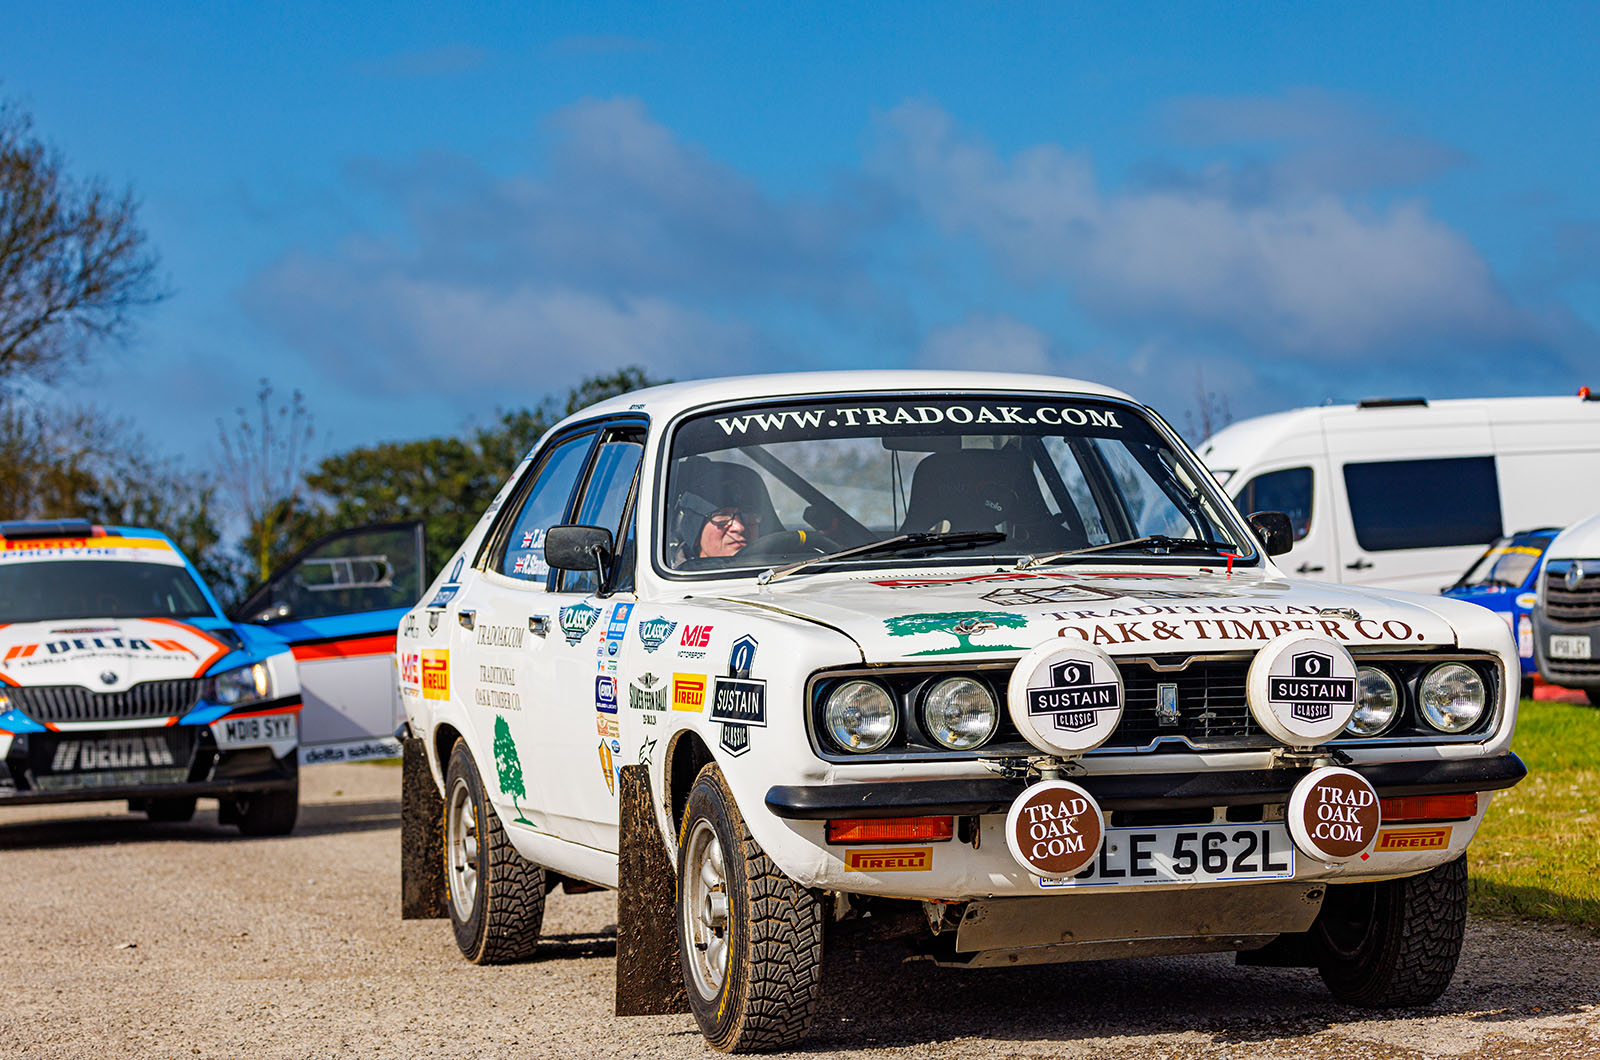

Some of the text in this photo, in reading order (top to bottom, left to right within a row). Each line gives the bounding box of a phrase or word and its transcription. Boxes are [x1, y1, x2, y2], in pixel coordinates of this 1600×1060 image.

[715, 405, 1122, 436] WWW.TRADOAK.COM
[565, 608, 594, 629] CLASSIC
[644, 623, 669, 639] CLASSIC
[680, 625, 714, 647] MIS
[1354, 619, 1425, 641] CO.
[46, 638, 152, 654] DELTA
[422, 659, 447, 690] PIRELLI
[480, 665, 516, 686] TRADITIONAL
[675, 680, 704, 706] PIRELLI
[717, 689, 759, 714] SUSTAIN
[1038, 690, 1110, 709] SUSTAIN
[1278, 683, 1347, 699] SUSTAIN
[1059, 712, 1092, 727] CLASSIC
[1296, 704, 1328, 717] CLASSIC
[264, 717, 291, 738] SYY
[724, 725, 746, 748] CLASSIC
[80, 738, 147, 769] DELTA
[305, 748, 345, 763] delta
[1317, 786, 1374, 807] TRAD
[1024, 798, 1088, 824] TRAD
[1317, 804, 1361, 824] OAK
[1029, 817, 1079, 841] OAK
[1311, 823, 1364, 842] .COM
[1380, 831, 1446, 848] PIRELLI
[1029, 834, 1086, 861] .COM
[1074, 830, 1288, 879] LE 562L
[851, 852, 926, 868] PIRELLI
